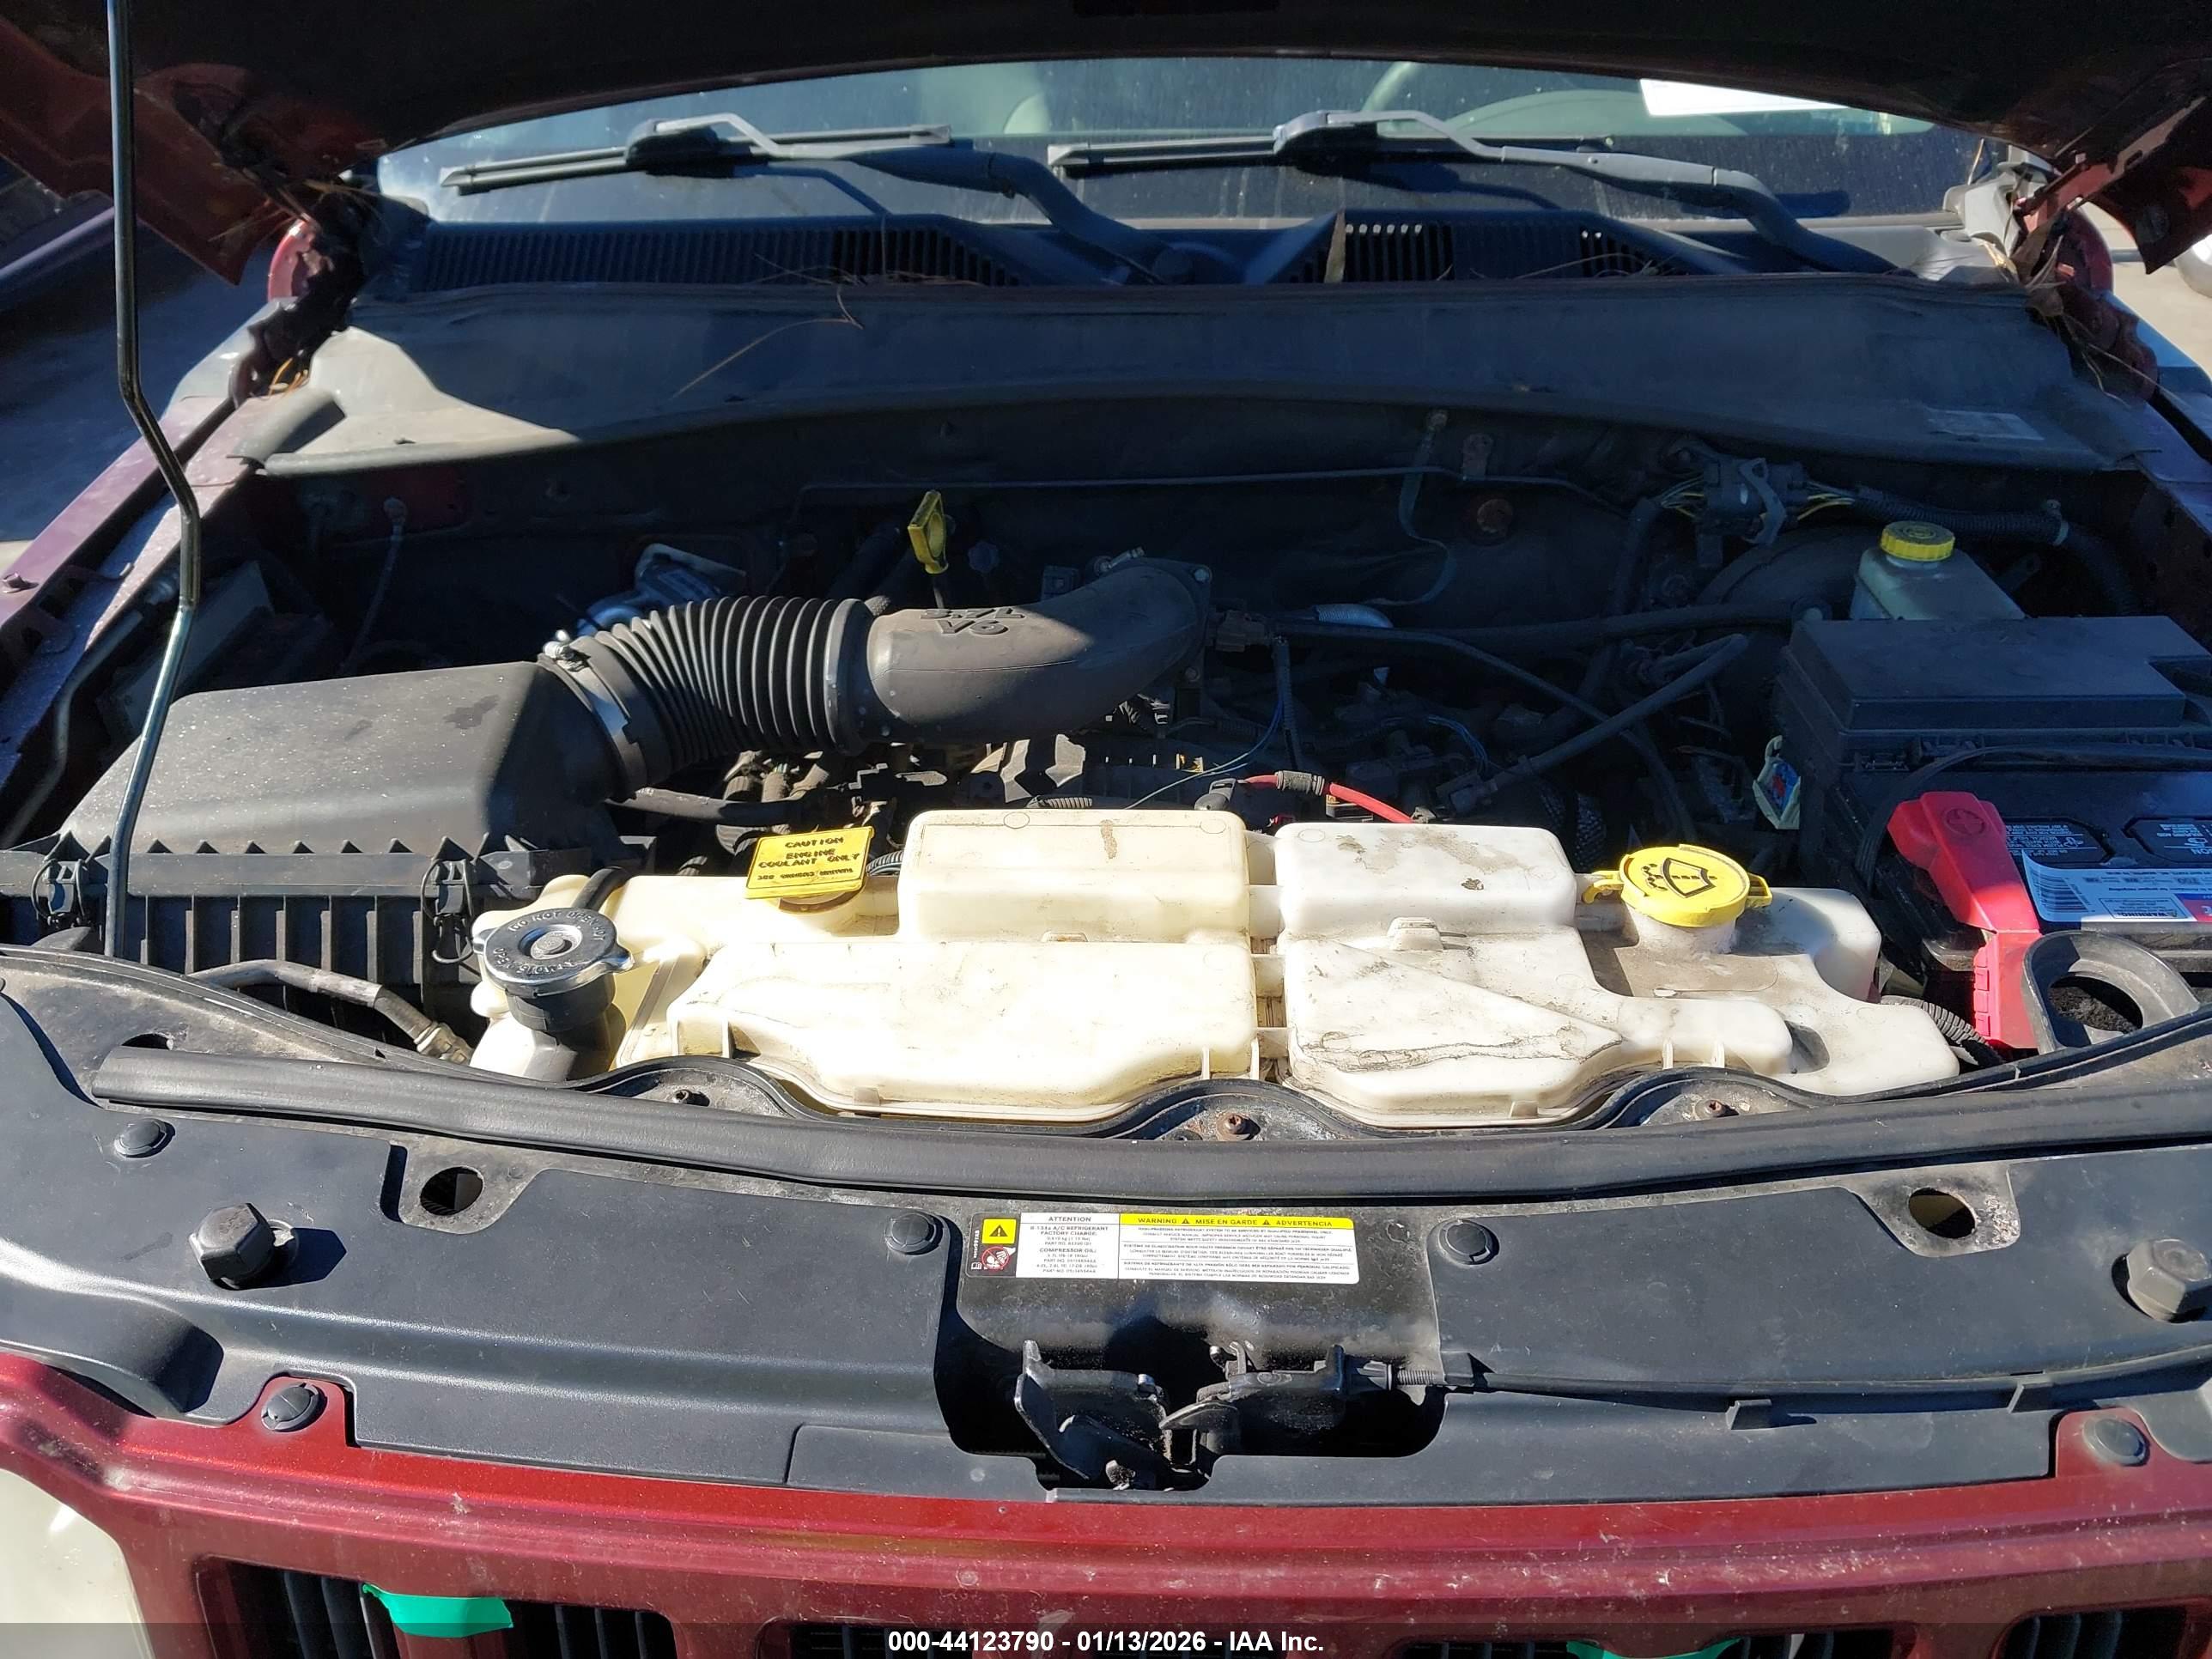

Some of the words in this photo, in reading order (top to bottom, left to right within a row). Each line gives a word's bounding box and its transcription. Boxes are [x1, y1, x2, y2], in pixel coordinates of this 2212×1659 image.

[920, 607, 1026, 619] 3.7L
[936, 620, 1009, 635] V6
[785, 836, 844, 848] CAUTION
[786, 848, 836, 860] ENGINE
[758, 858, 817, 869] COOLANT
[827, 853, 860, 863] ONLY
[507, 920, 528, 933] DO
[532, 911, 561, 921] NOT
[567, 911, 599, 928] OPEN
